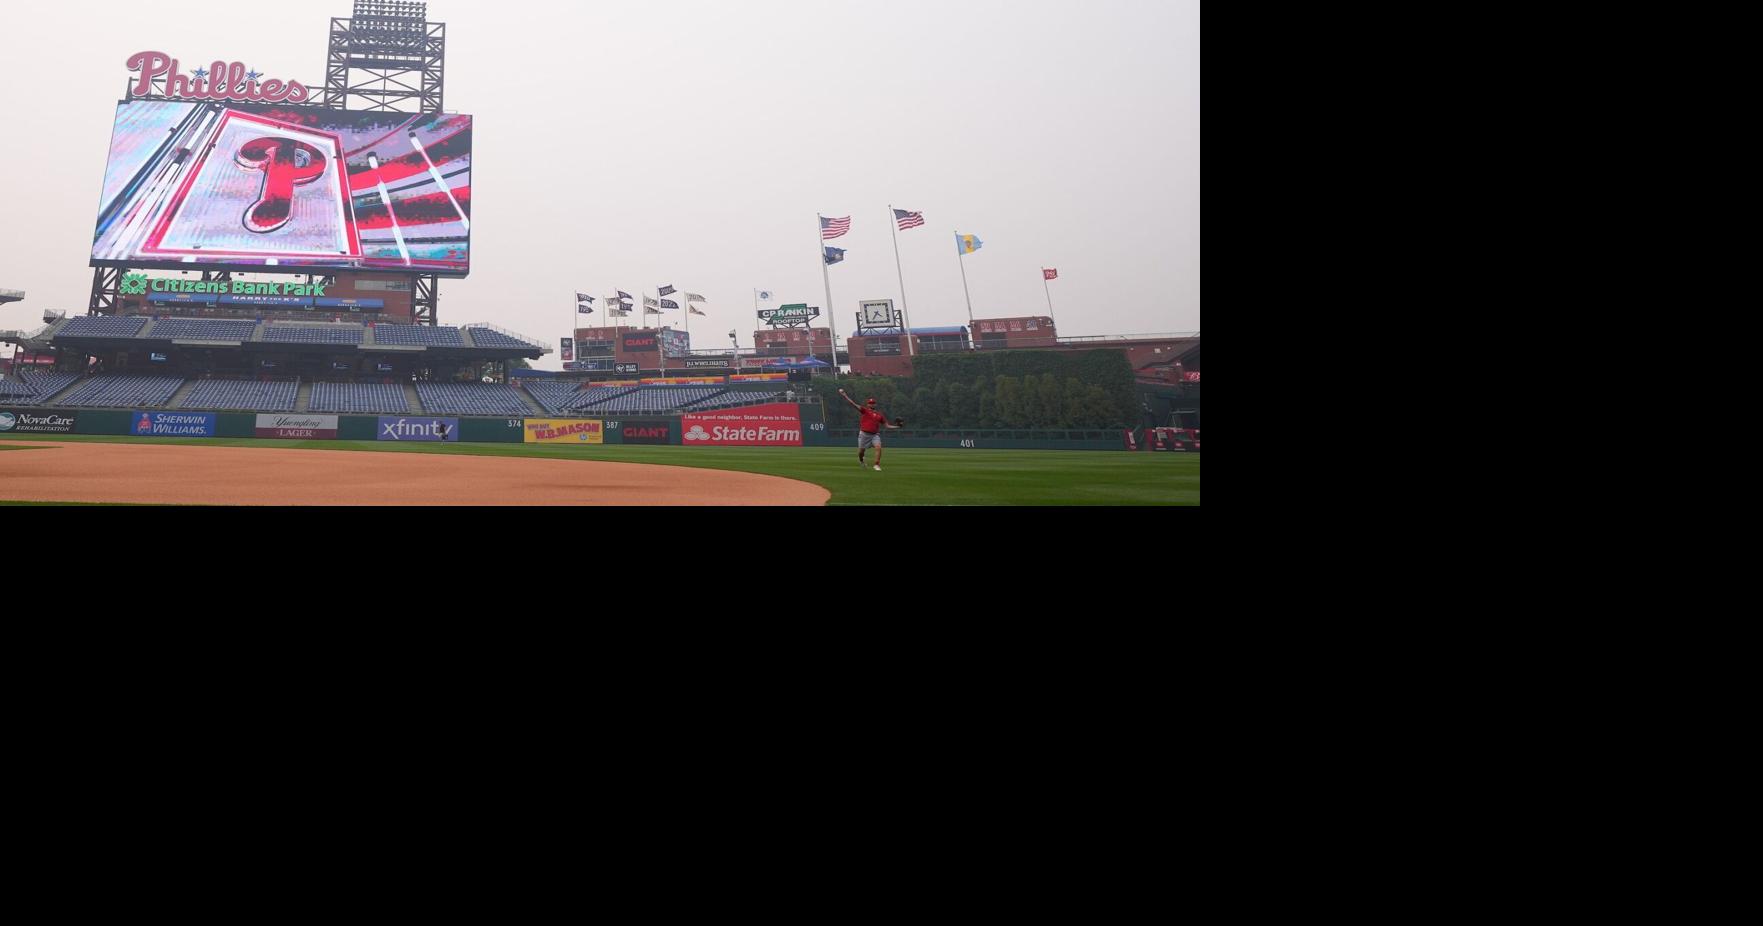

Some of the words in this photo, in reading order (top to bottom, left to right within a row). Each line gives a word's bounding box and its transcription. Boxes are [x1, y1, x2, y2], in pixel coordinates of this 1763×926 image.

[126, 51, 308, 103] Phillies
[234, 137, 328, 233] P
[151, 278, 228, 294] Citizens
[232, 281, 280, 296] Bank
[284, 282, 326, 297] Park
[777, 308, 814, 317] RANKIN
[625, 338, 654, 346] GIANT
[16, 414, 74, 426] NovaCare
[155, 413, 206, 425] SHERWIN
[271, 415, 323, 429] Yuengling
[383, 418, 453, 440] xfinity
[606, 421, 618, 429] 387
[810, 423, 824, 431] 409
[278, 428, 313, 437] LAGER
[623, 427, 668, 438] GIANT
[960, 439, 974, 447] 401
